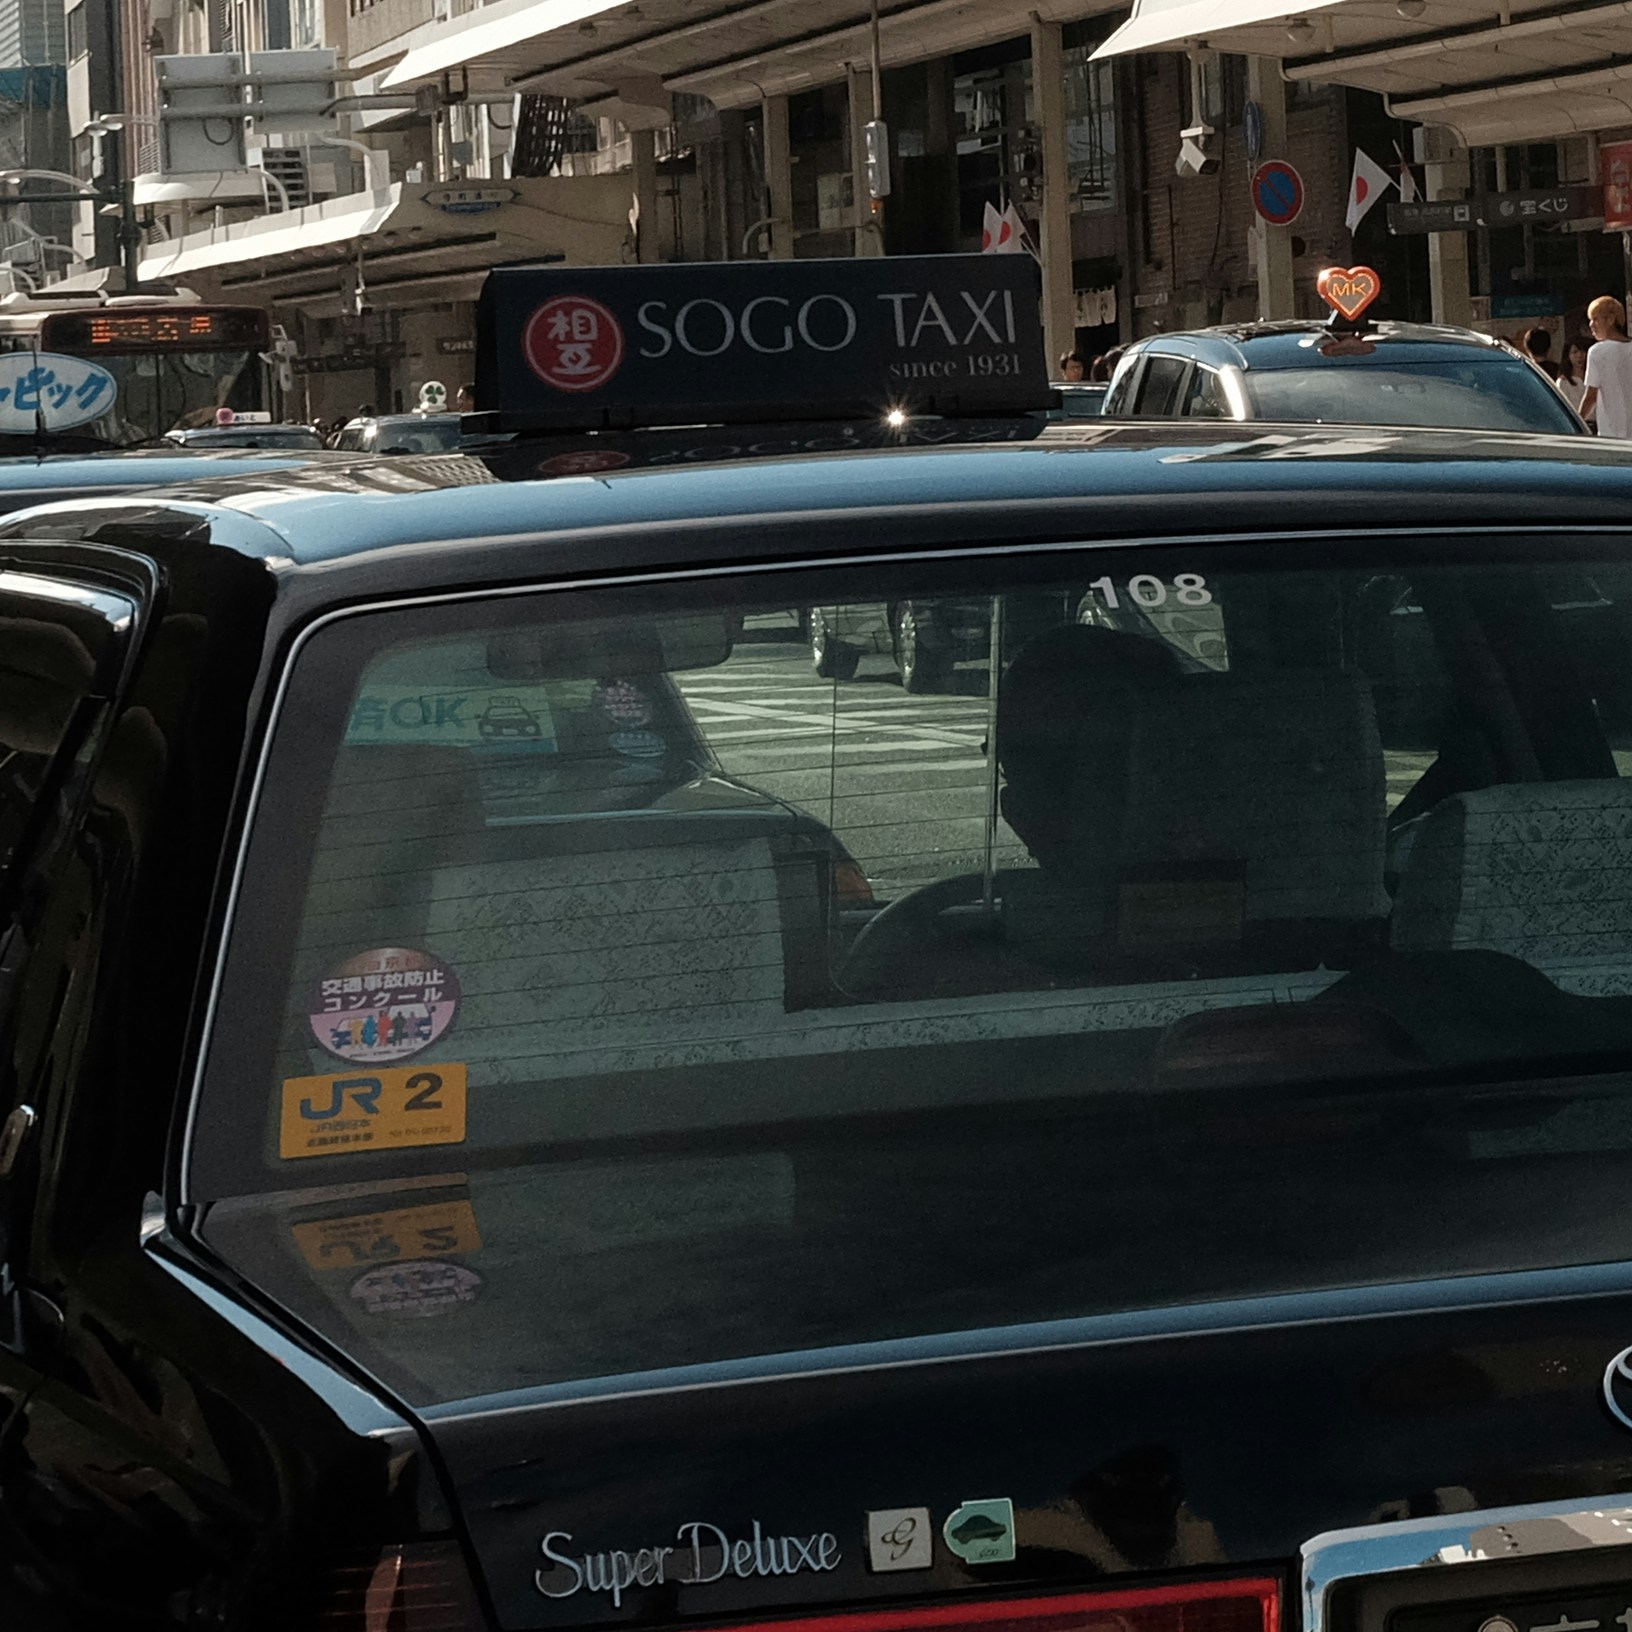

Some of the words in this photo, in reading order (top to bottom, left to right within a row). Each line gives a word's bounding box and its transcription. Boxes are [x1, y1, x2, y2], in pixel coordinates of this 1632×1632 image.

[1519, 197, 1569, 216] 宝くじ
[1332, 282, 1367, 297] MK
[637, 293, 857, 358] SOGO
[877, 289, 1017, 348] TAXI
[890, 356, 958, 379] since
[967, 353, 1022, 378] 1931
[1089, 573, 1213, 609] 108
[321, 968, 445, 996] 交通事故防止
[323, 987, 443, 1012] コンクール
[300, 1077, 383, 1120] JR
[404, 1072, 443, 1112] 2
[535, 1531, 674, 1609] Super
[676, 1518, 843, 1585] Deluxe
